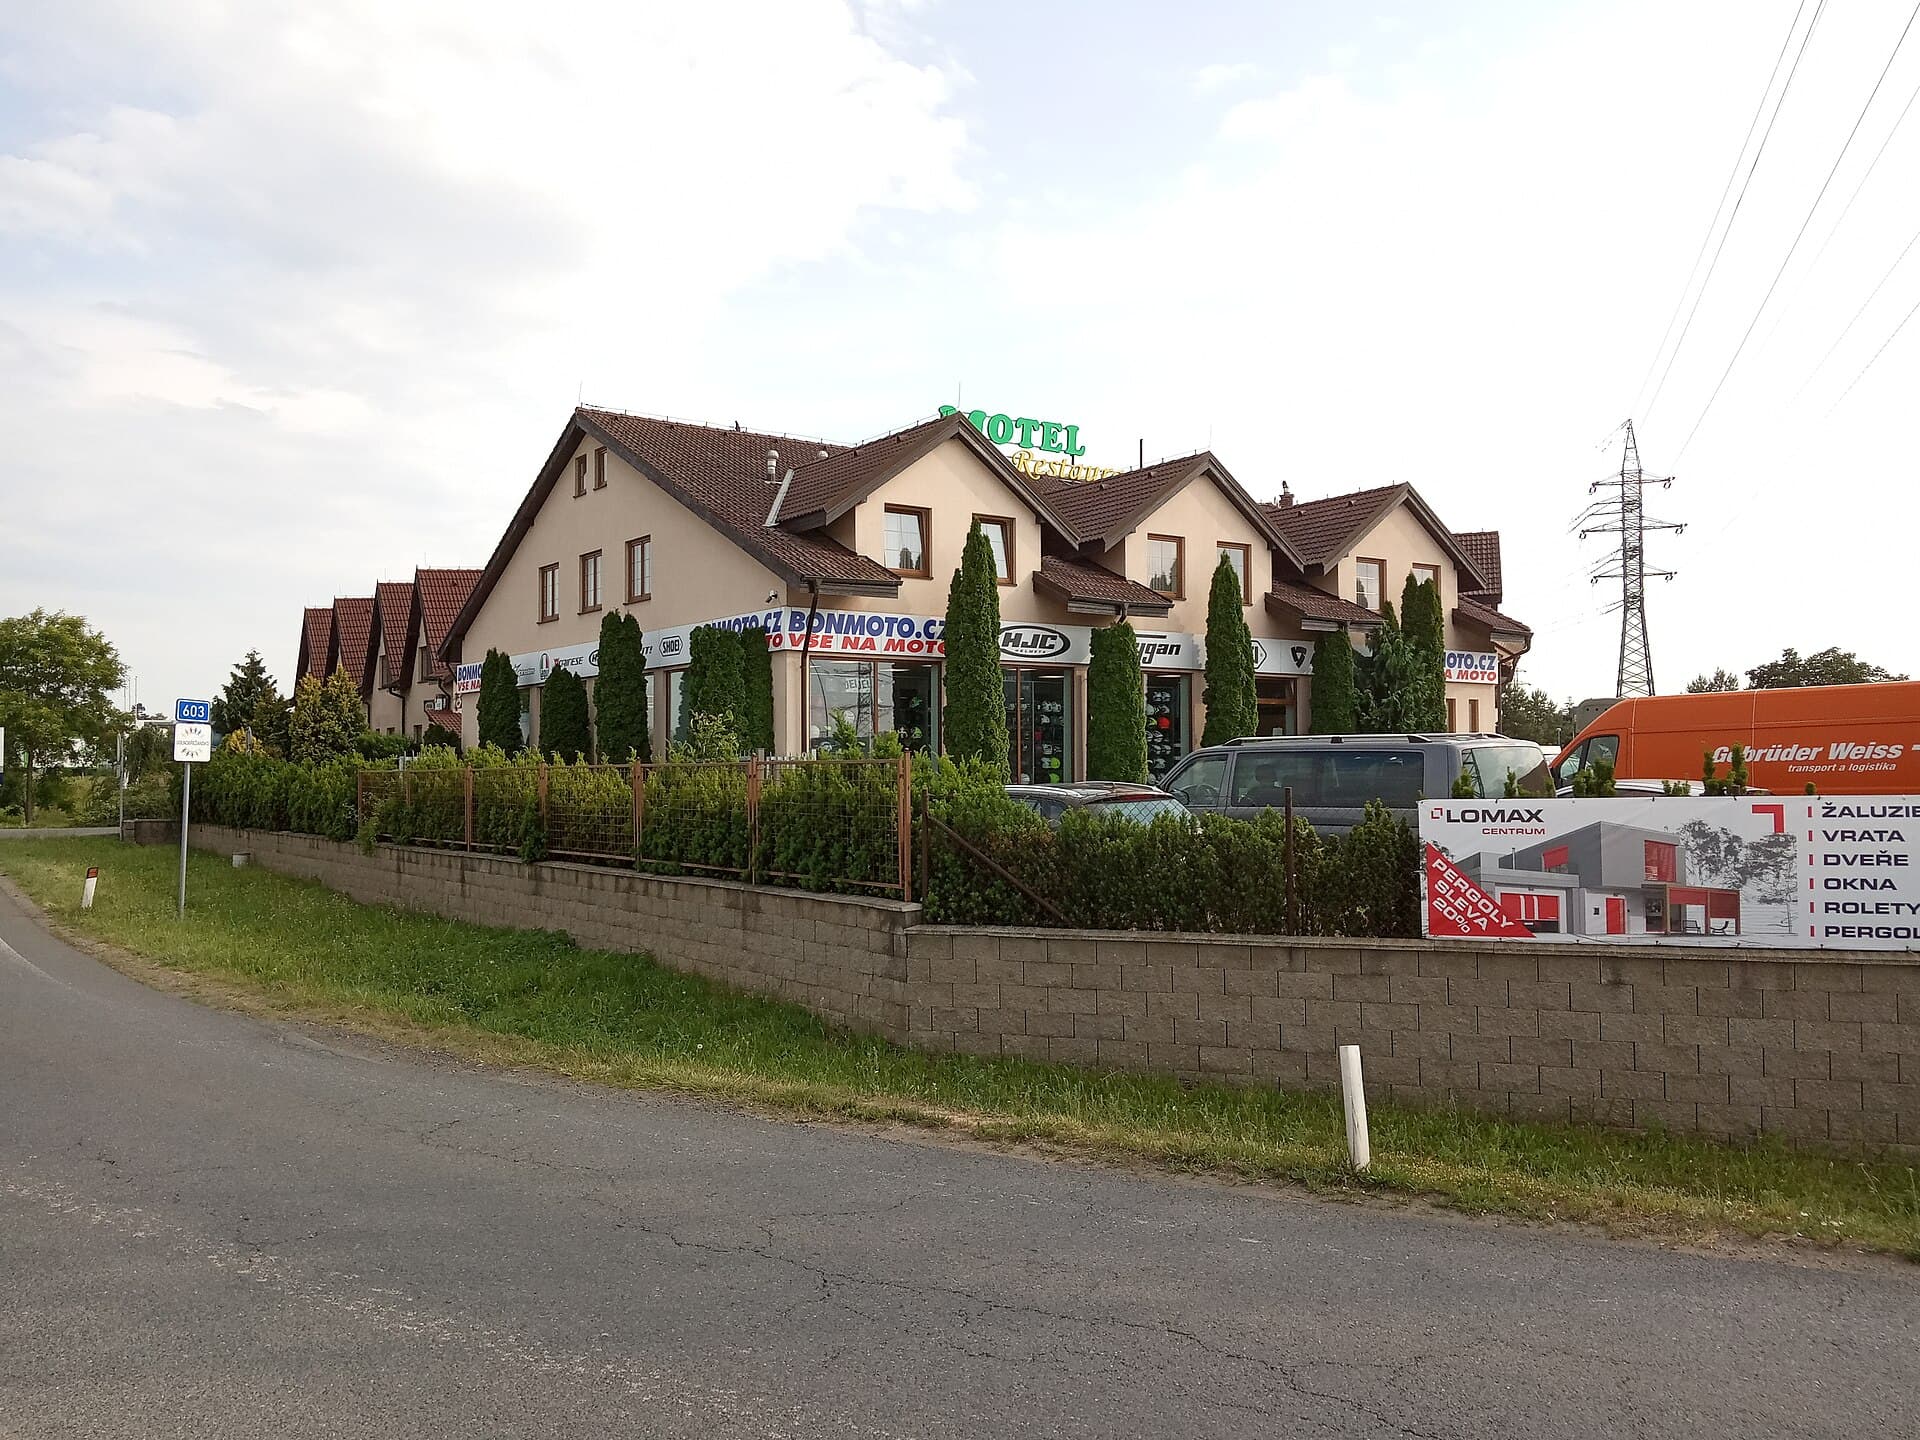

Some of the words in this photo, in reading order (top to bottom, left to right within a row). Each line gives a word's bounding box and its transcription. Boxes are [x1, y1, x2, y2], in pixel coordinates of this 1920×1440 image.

[1012, 450, 1120, 480] Restaur
[788, 611, 945, 640] BONMOTO.CZ
[663, 639, 680, 653] SHOEI
[765, 633, 783, 648] TO
[789, 633, 833, 648] VŠE
[841, 636, 876, 650] NA
[1002, 632, 1058, 649] HJC
[1444, 652, 1496, 671] OTO.CZ
[458, 664, 482, 682] BONMO
[1456, 670, 1496, 681] MOTO
[182, 705, 205, 717] 603
[1828, 742, 1904, 760] Weiss
[1788, 763, 1837, 773] transport
[1838, 764, 1846, 772] a
[1848, 762, 1896, 773] logistika
[1447, 809, 1544, 823] LOMAX
[1822, 802, 1920, 818] ŽALUZIE
[1822, 830, 1905, 842] VRATA
[1823, 850, 1909, 866] DVEŘE
[1823, 878, 1897, 890] OKNA
[1432, 859, 1514, 928] PERGOLY
[1435, 879, 1488, 931] SLEVA
[1824, 902, 1920, 915] ROLETY
[1432, 897, 1471, 933] 20%
